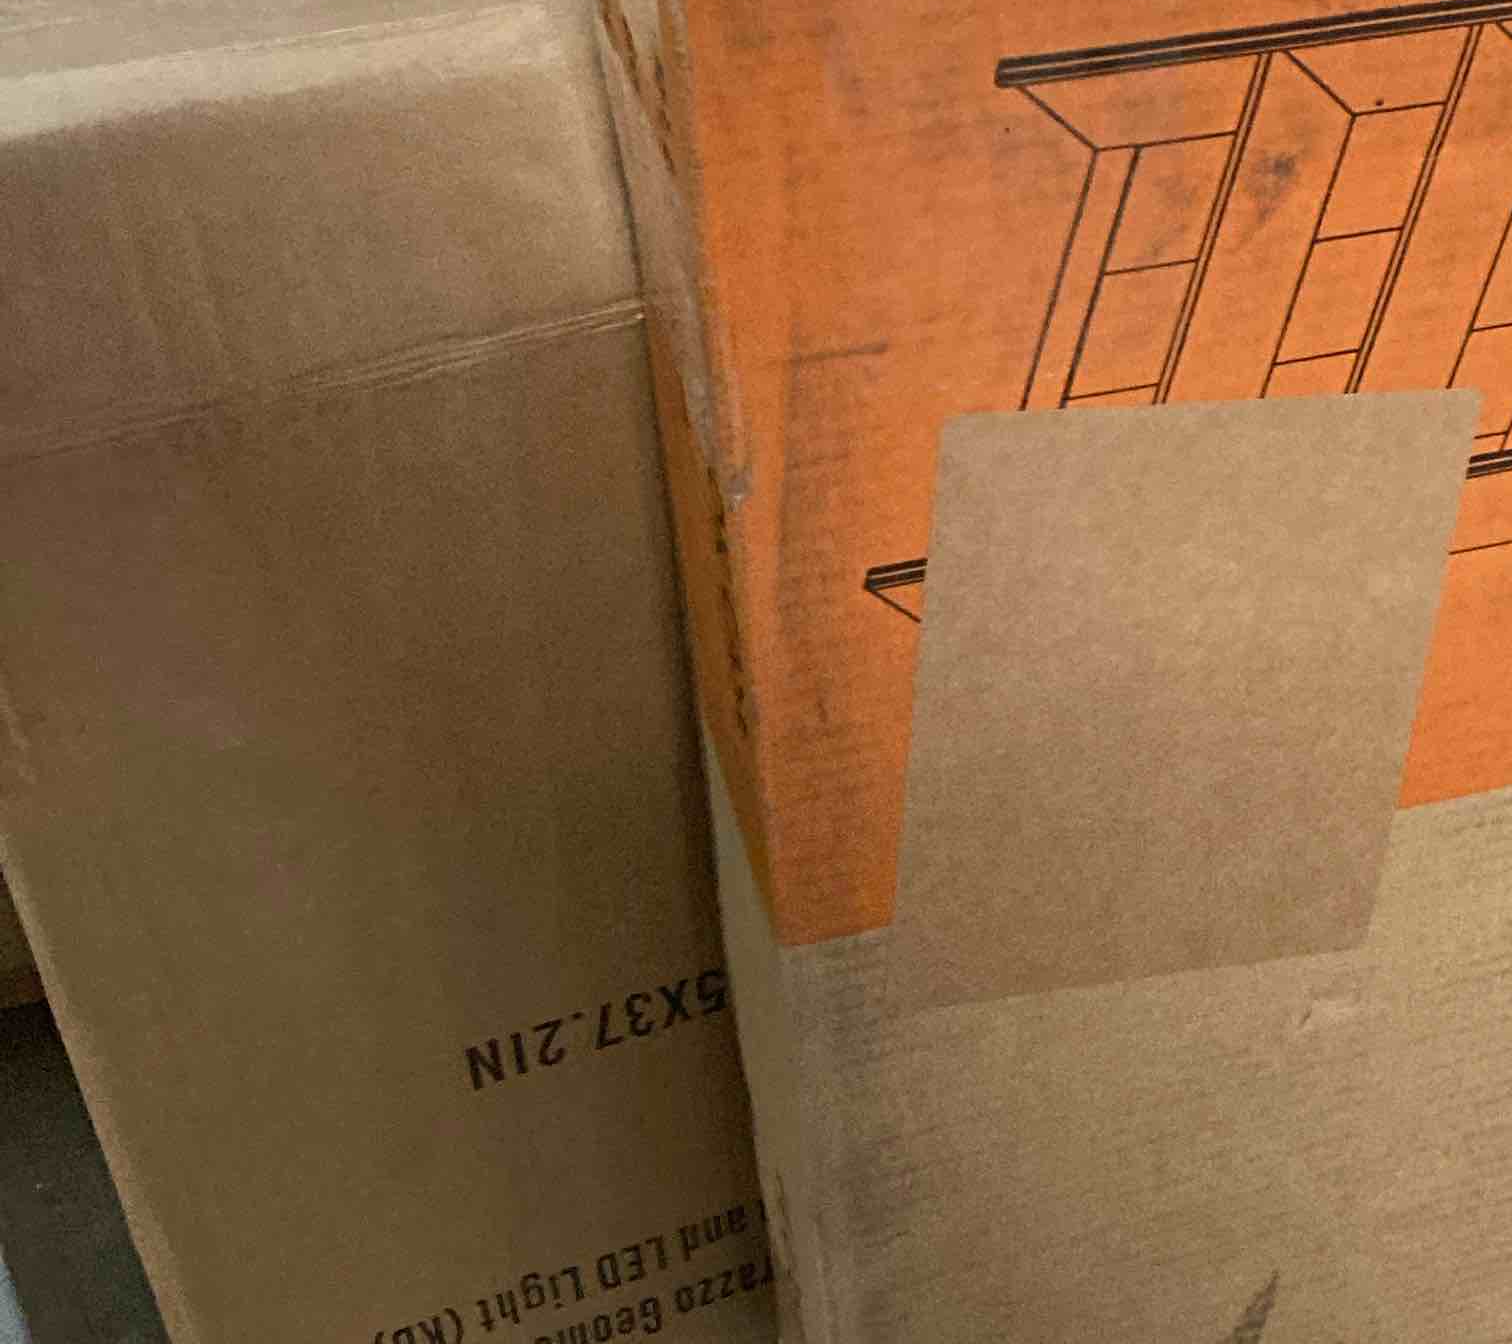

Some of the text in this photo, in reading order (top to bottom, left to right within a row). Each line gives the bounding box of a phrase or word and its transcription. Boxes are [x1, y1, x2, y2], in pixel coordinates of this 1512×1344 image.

[679, 1205, 749, 1249] and
[596, 1235, 669, 1289] LED
[478, 1265, 586, 1333] Light
